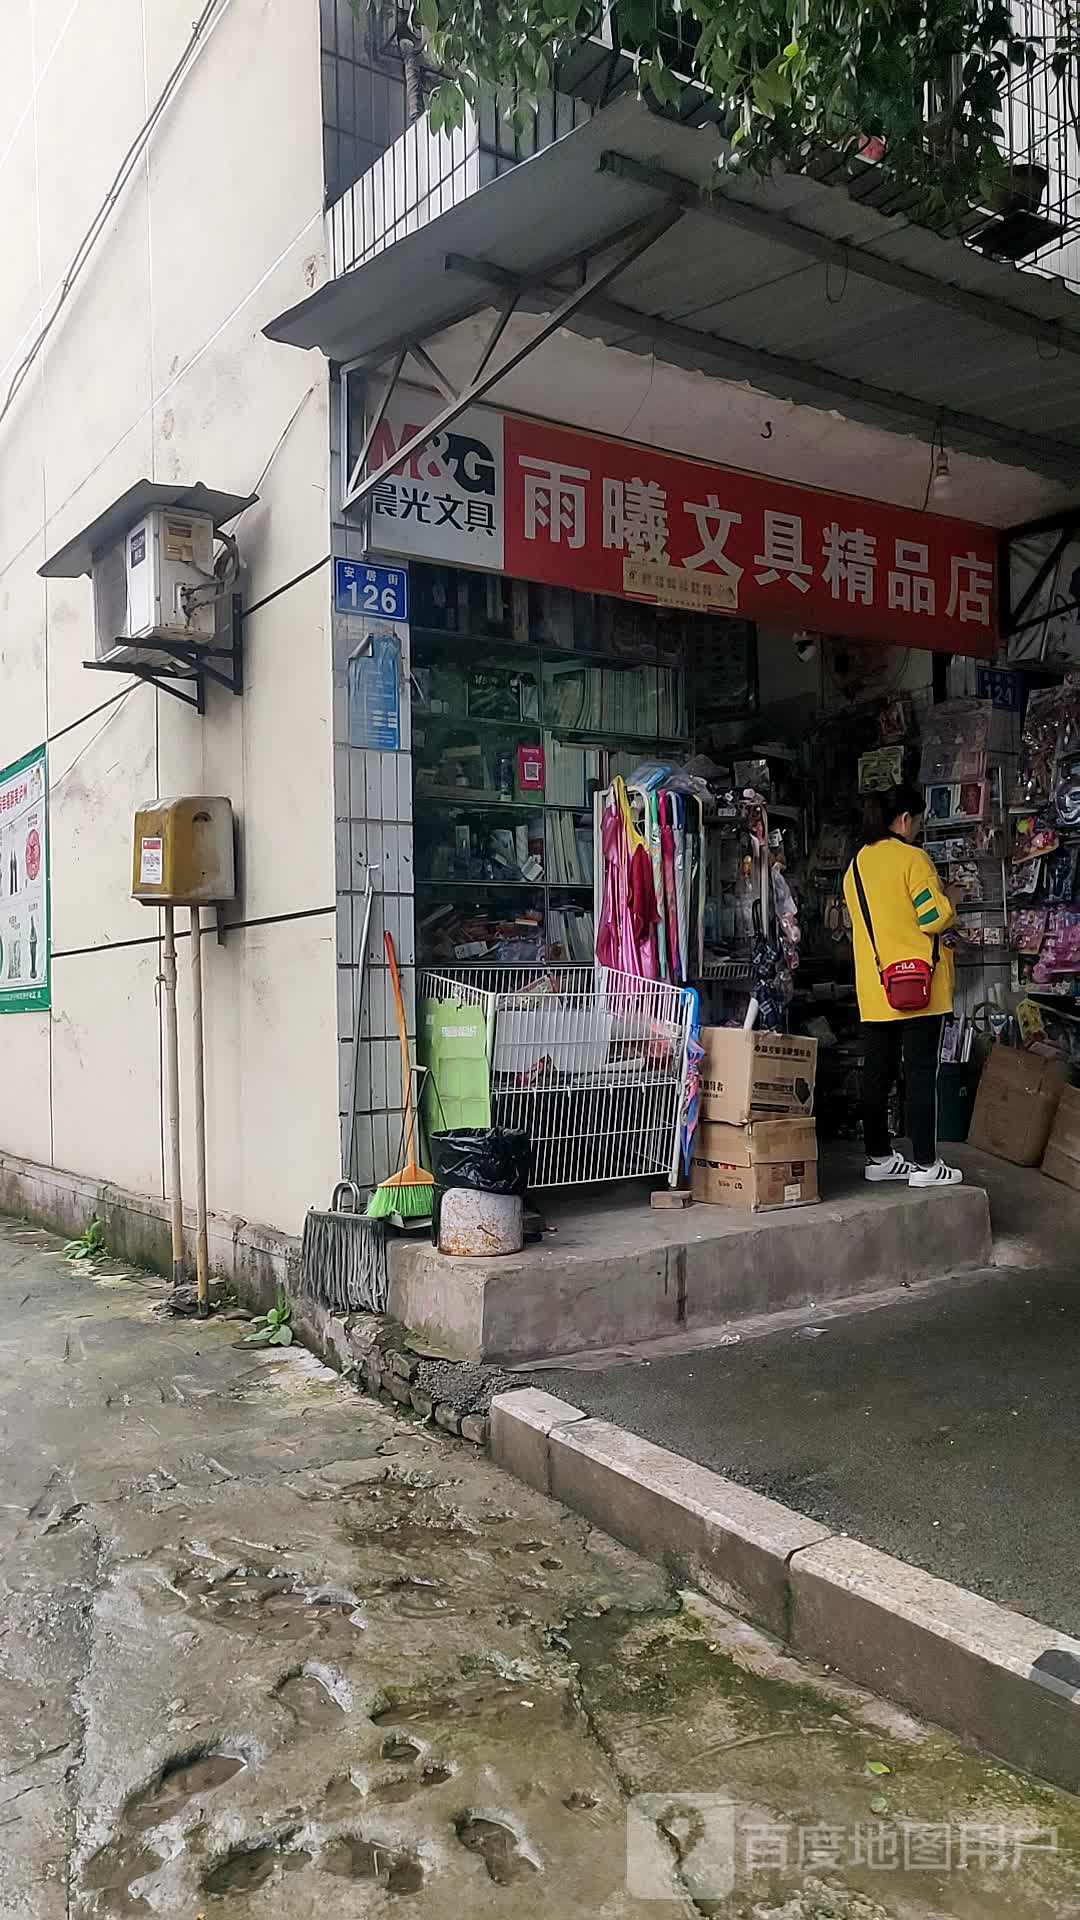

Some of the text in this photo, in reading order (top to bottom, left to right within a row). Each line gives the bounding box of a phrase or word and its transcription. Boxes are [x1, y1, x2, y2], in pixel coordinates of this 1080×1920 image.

[367, 417, 496, 497] M&G
[371, 481, 497, 537] 晨光文具
[518, 455, 994, 626] 雨曦文具精品店
[343, 565, 399, 586] 安居街
[346, 581, 397, 614] 126
[984, 683, 1013, 705] 124
